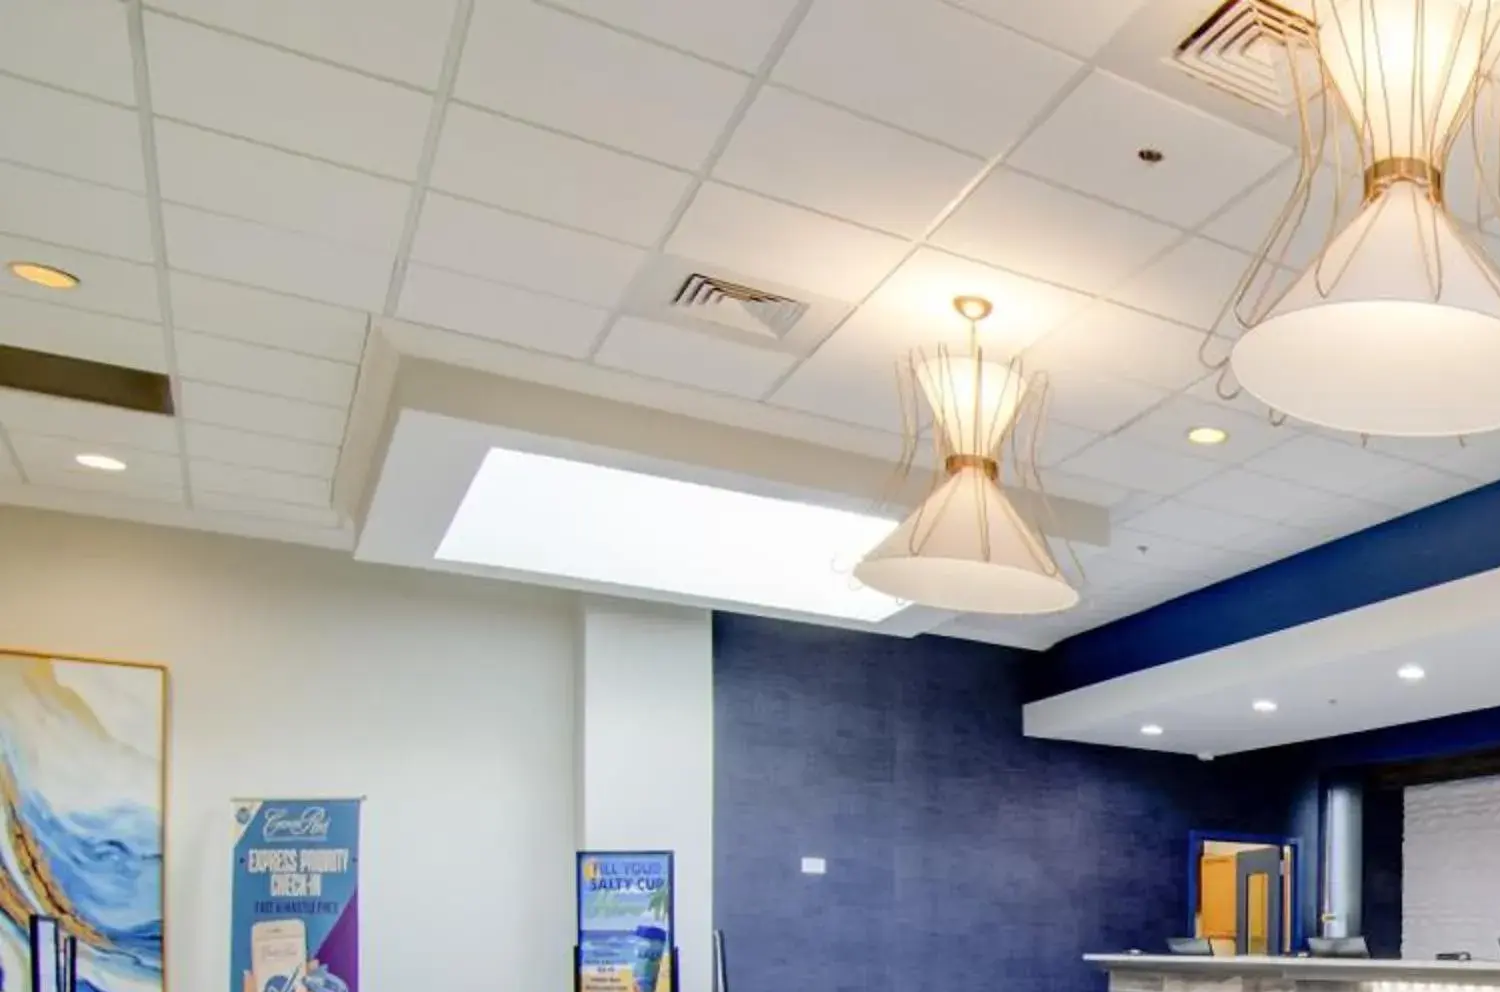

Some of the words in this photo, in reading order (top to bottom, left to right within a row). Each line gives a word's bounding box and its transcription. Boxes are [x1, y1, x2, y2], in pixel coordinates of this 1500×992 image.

[248, 848, 298, 873] EXPRESS
[590, 878, 633, 891] SALTY
[637, 877, 665, 891] CUP
